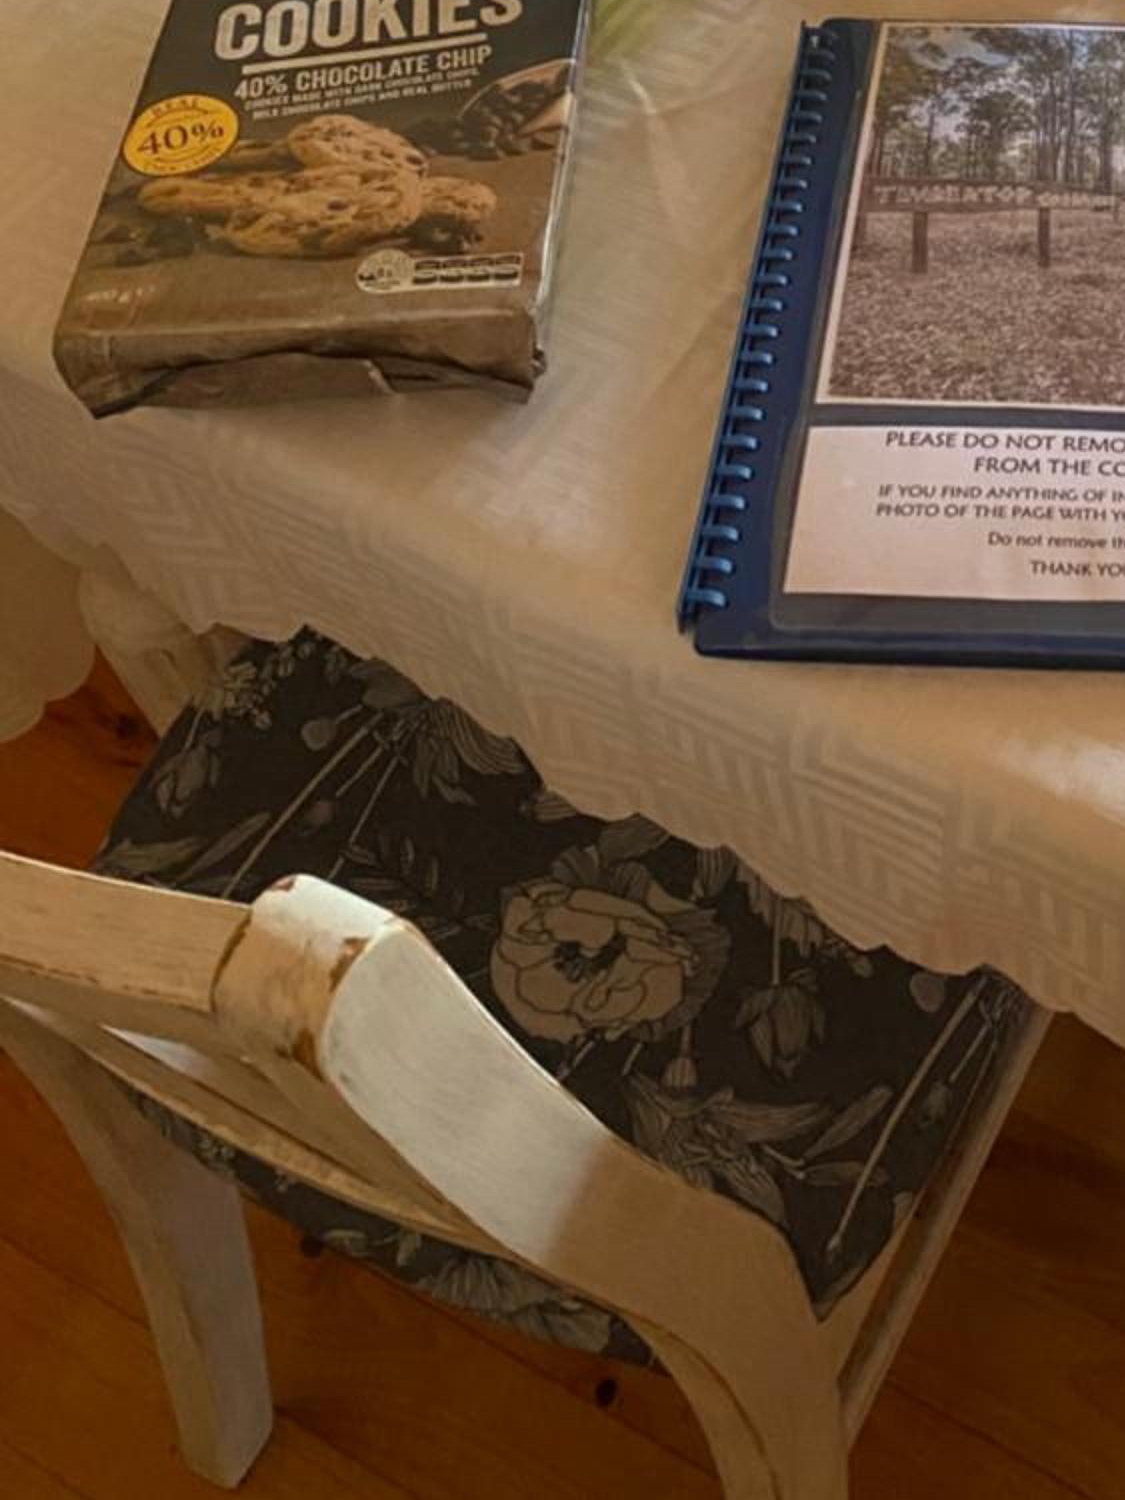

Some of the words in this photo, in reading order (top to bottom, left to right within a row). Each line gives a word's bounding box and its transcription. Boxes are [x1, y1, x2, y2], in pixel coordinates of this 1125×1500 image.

[233, 73, 288, 100] 40%
[296, 52, 431, 92] CHOCOLATE
[436, 44, 492, 70] CHIP
[138, 120, 224, 155] 40%
[885, 430, 957, 449] PLEASE
[963, 433, 999, 449] DO
[1005, 435, 1057, 451] NOT
[974, 456, 1041, 474] FROM
[1047, 459, 1092, 476] THE
[878, 484, 893, 497] IF
[898, 485, 936, 498] YOU
[940, 486, 982, 499] FIND
[986, 487, 1078, 502] ANYTHING
[1083, 489, 1106, 502] OF
[876, 503, 939, 517] PHOTO
[944, 504, 969, 518] OF
[974, 505, 1006, 519] THE
[1011, 506, 1056, 520] PAGE
[1060, 507, 1106, 521] WITH
[988, 532, 1012, 546] Do
[1016, 534, 1043, 547] not
[1047, 536, 1107, 549] remove
[1030, 560, 1092, 576] THANK
